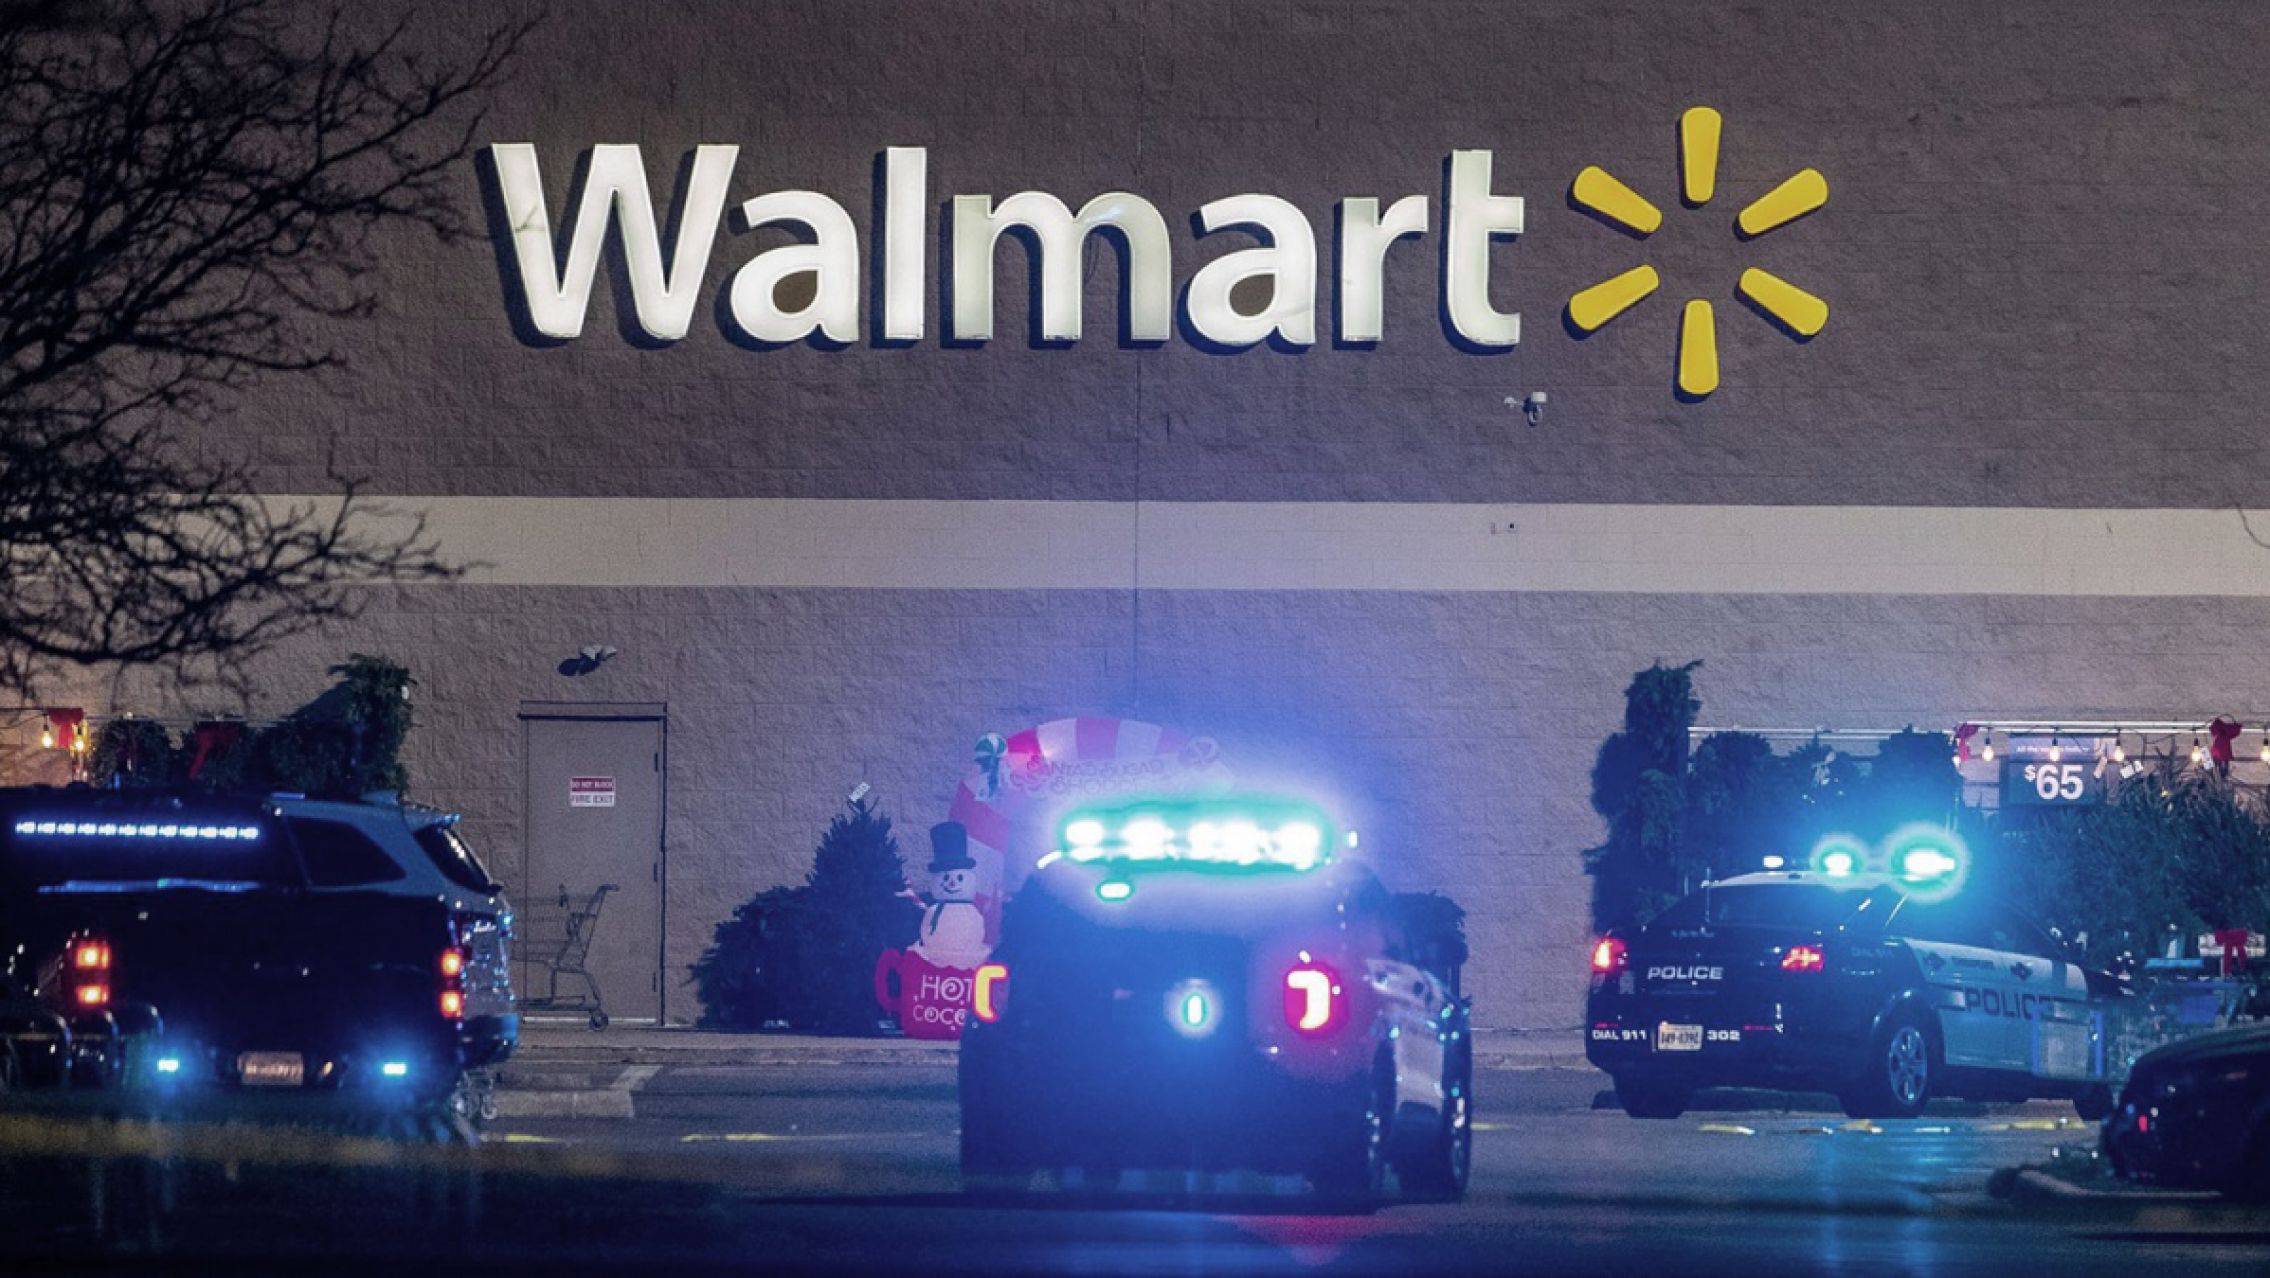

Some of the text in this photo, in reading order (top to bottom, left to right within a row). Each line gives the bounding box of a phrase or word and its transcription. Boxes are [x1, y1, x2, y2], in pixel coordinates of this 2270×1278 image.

[491, 142, 1524, 345] Walmart
[2024, 764, 2084, 800] $65
[593, 794, 613, 804] EXIT
[1647, 965, 1724, 980] POLICE
[921, 974, 973, 1004] HOT
[1592, 1029, 1647, 1041] DIAL 911
[1707, 1029, 1741, 1042] 302
